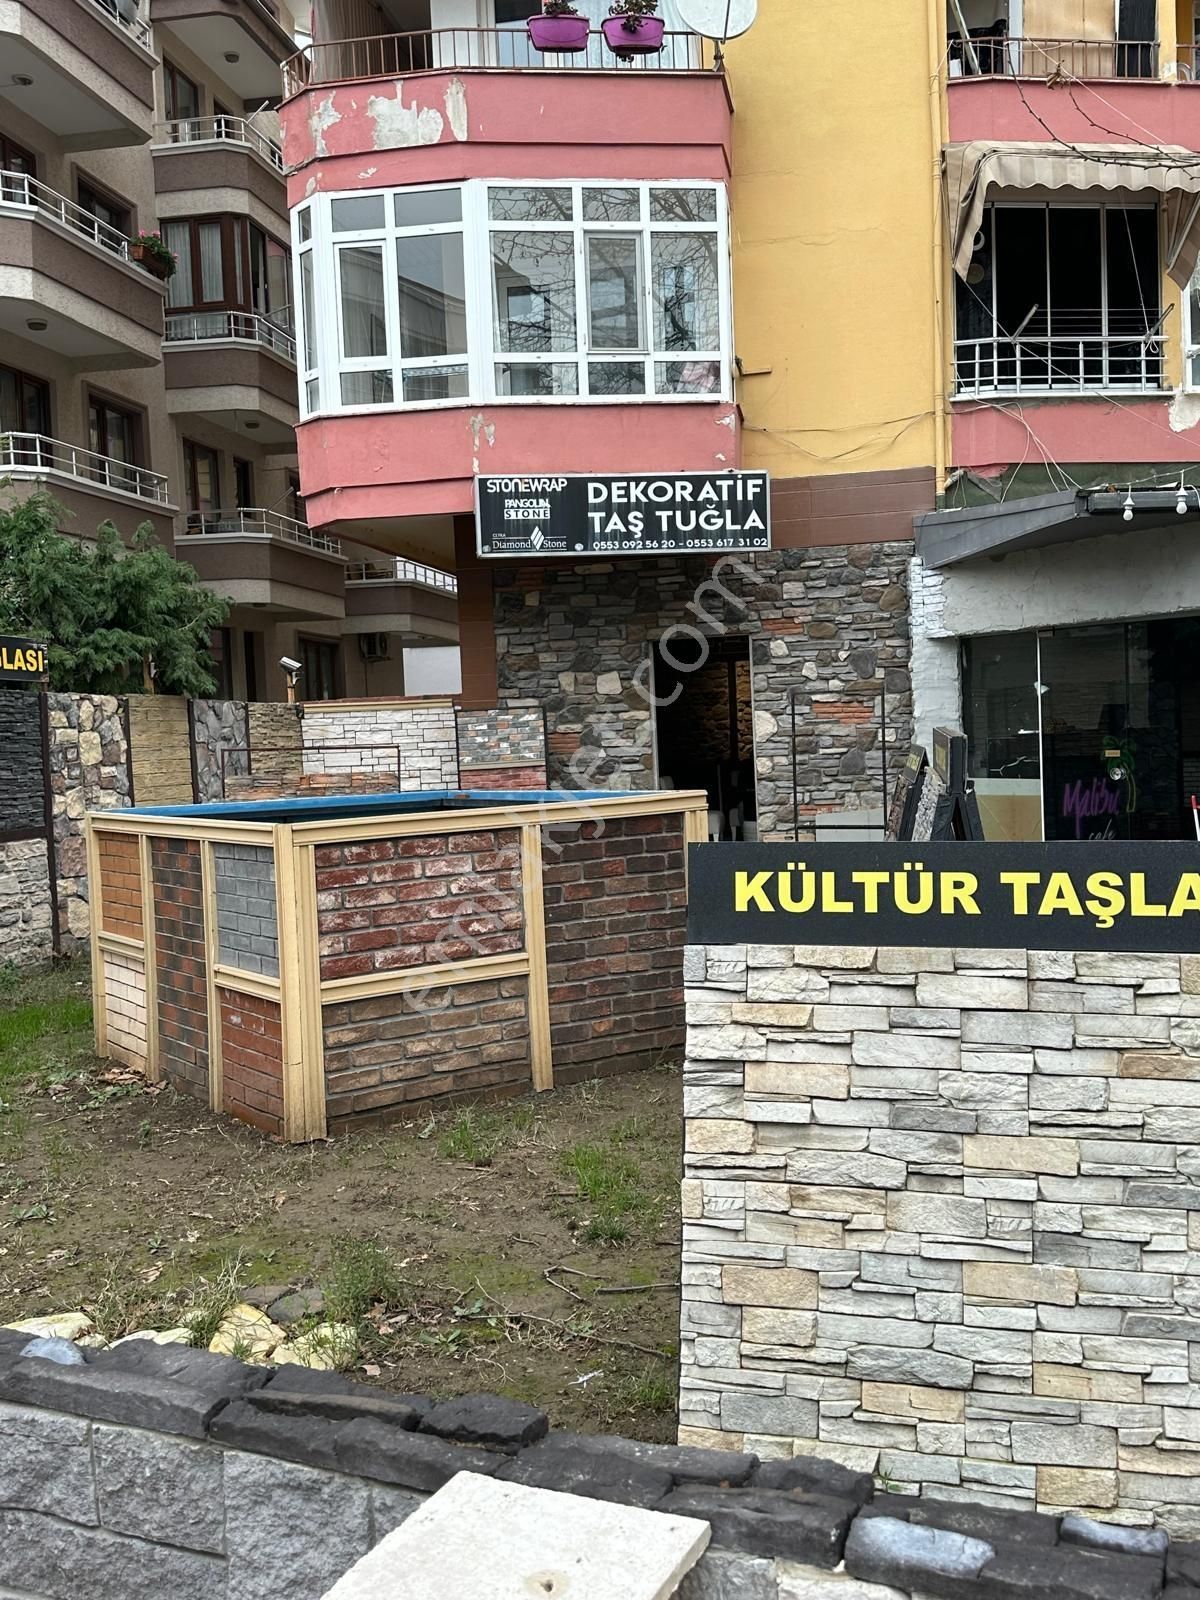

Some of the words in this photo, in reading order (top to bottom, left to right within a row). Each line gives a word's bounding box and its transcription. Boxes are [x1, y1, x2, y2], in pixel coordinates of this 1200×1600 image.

[587, 474, 763, 503] DEKORATİF
[505, 509, 549, 518] STONE
[587, 511, 644, 539] TAŞ
[655, 503, 766, 533] TUĞLA
[492, 539, 531, 549] Diamond
[543, 539, 567, 548] Stone
[593, 541, 619, 550] 0553
[622, 540, 643, 550] 092
[645, 539, 659, 548] 56
[661, 539, 676, 548] 20
[686, 538, 714, 548] 0553
[716, 538, 734, 547] 617
[738, 538, 750, 547] 31
[753, 537, 768, 547] 02
[0, 647, 44, 672] LASI
[734, 862, 982, 915] KÜLTÜR
[1000, 871, 1200, 928] TAŞLA
